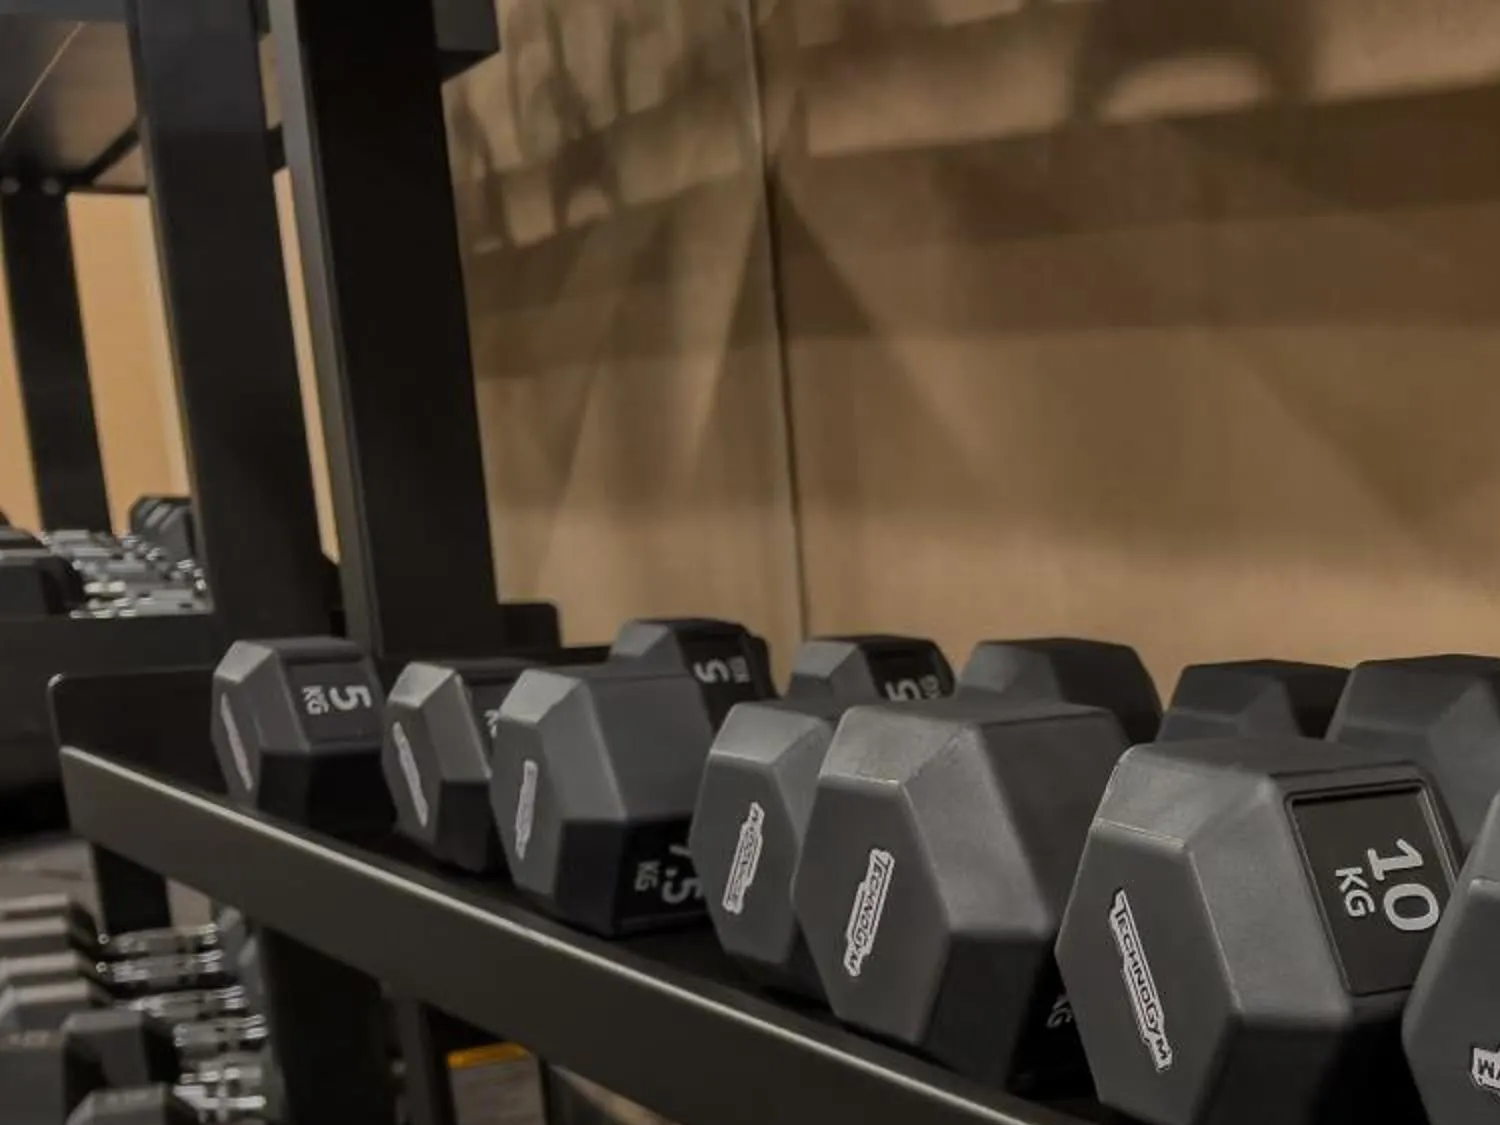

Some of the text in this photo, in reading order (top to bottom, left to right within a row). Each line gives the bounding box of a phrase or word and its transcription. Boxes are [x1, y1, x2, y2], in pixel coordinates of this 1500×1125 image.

[302, 685, 330, 715] KG
[329, 684, 372, 712] 5
[1335, 866, 1376, 918] KG
[1367, 838, 1439, 932] 10
[1110, 889, 1172, 1072] TECHNOGYM
